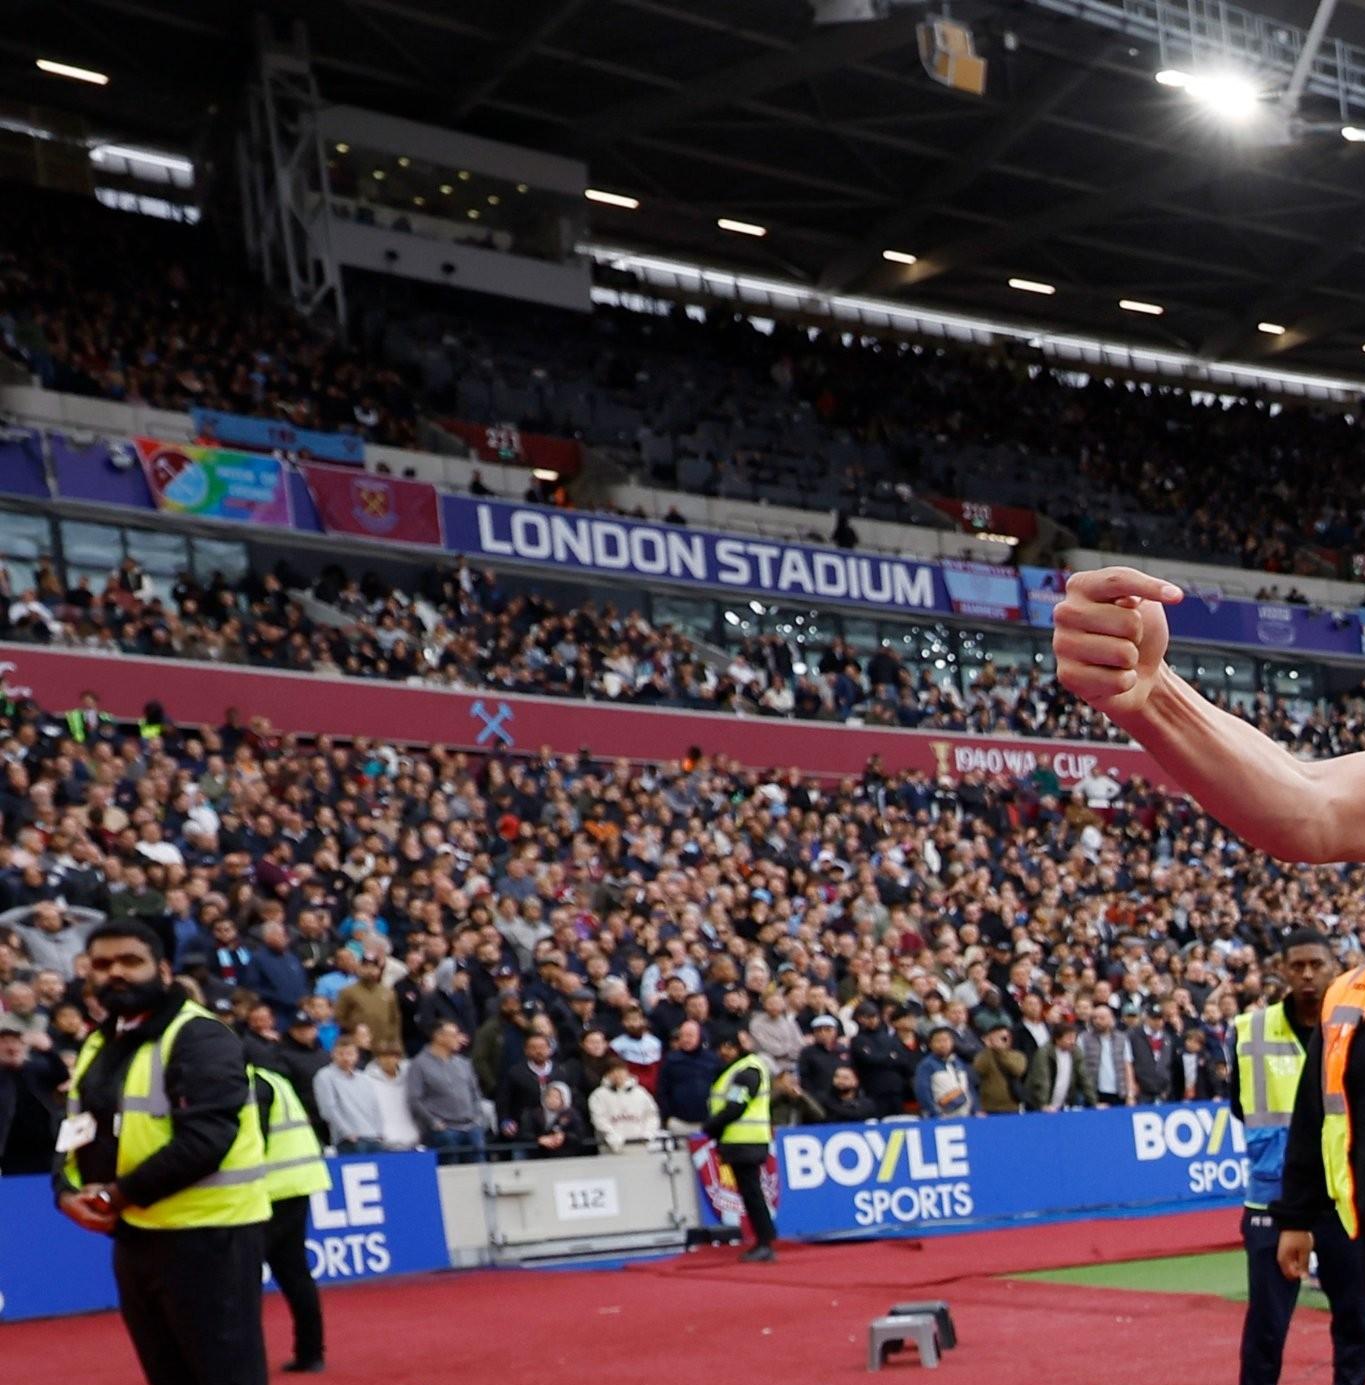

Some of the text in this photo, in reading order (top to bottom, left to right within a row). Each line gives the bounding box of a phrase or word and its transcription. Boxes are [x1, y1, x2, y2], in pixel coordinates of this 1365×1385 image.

[477, 503, 935, 608] LONDON STADIUM
[955, 746, 1098, 779] 1940 WA CUP
[783, 1124, 970, 1191] BOYLE
[568, 1187, 608, 1210] 112
[854, 1181, 974, 1226] SPORTS
